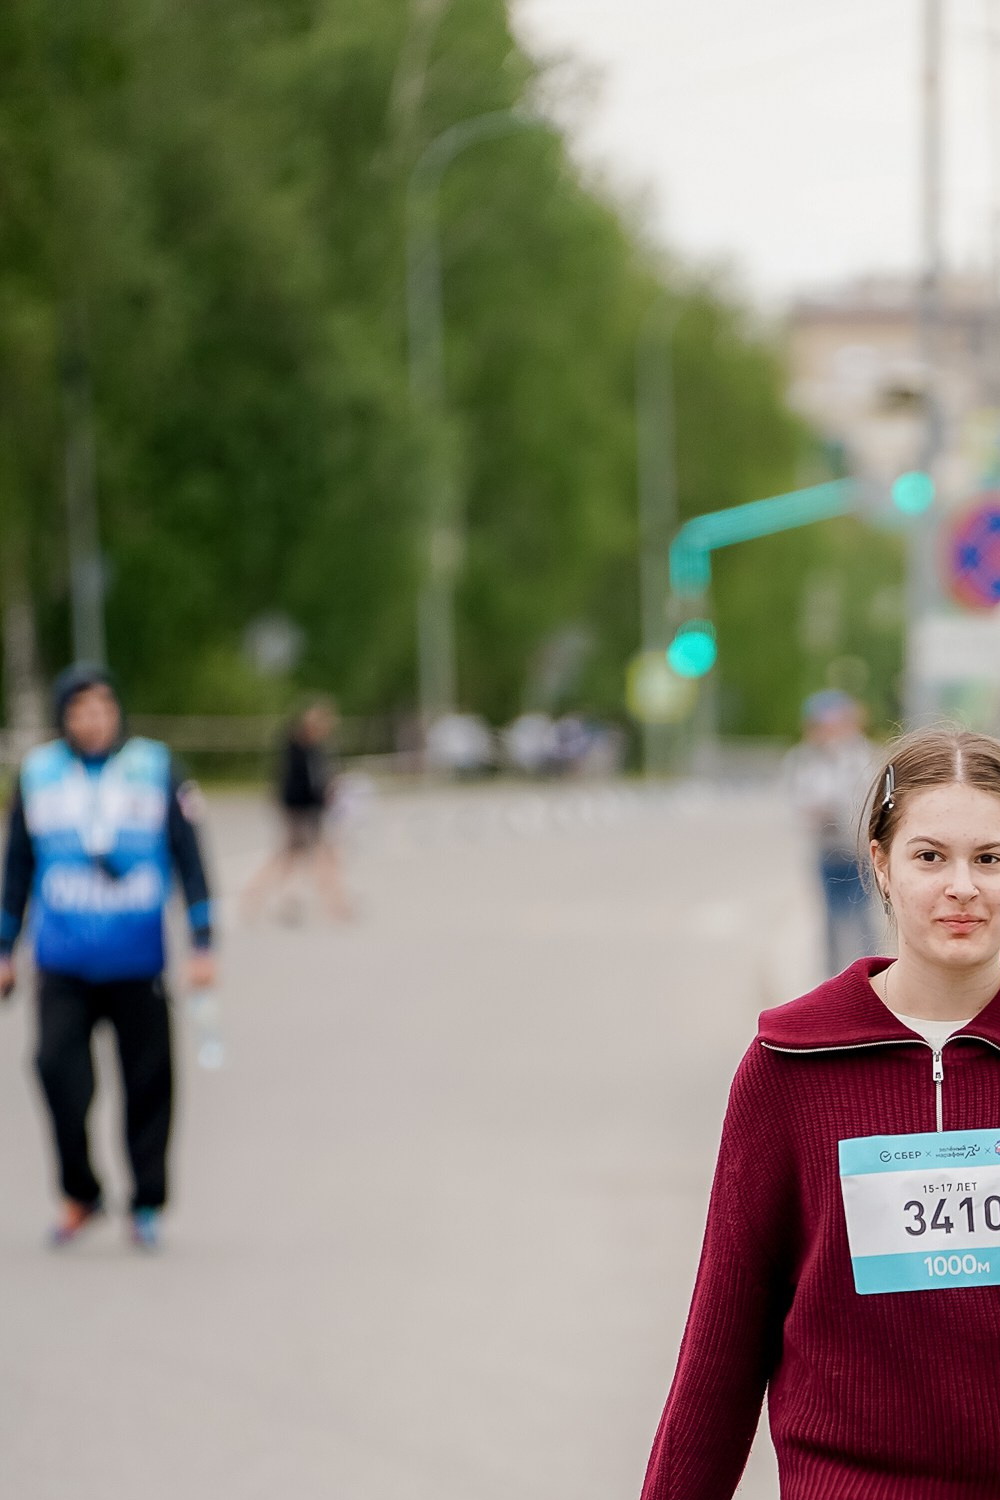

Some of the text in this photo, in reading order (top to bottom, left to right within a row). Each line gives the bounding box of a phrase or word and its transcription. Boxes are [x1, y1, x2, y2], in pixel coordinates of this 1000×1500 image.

[894, 1151, 922, 1160] СБЕР
[923, 1182, 977, 1193] 15-17 ЛЕТ
